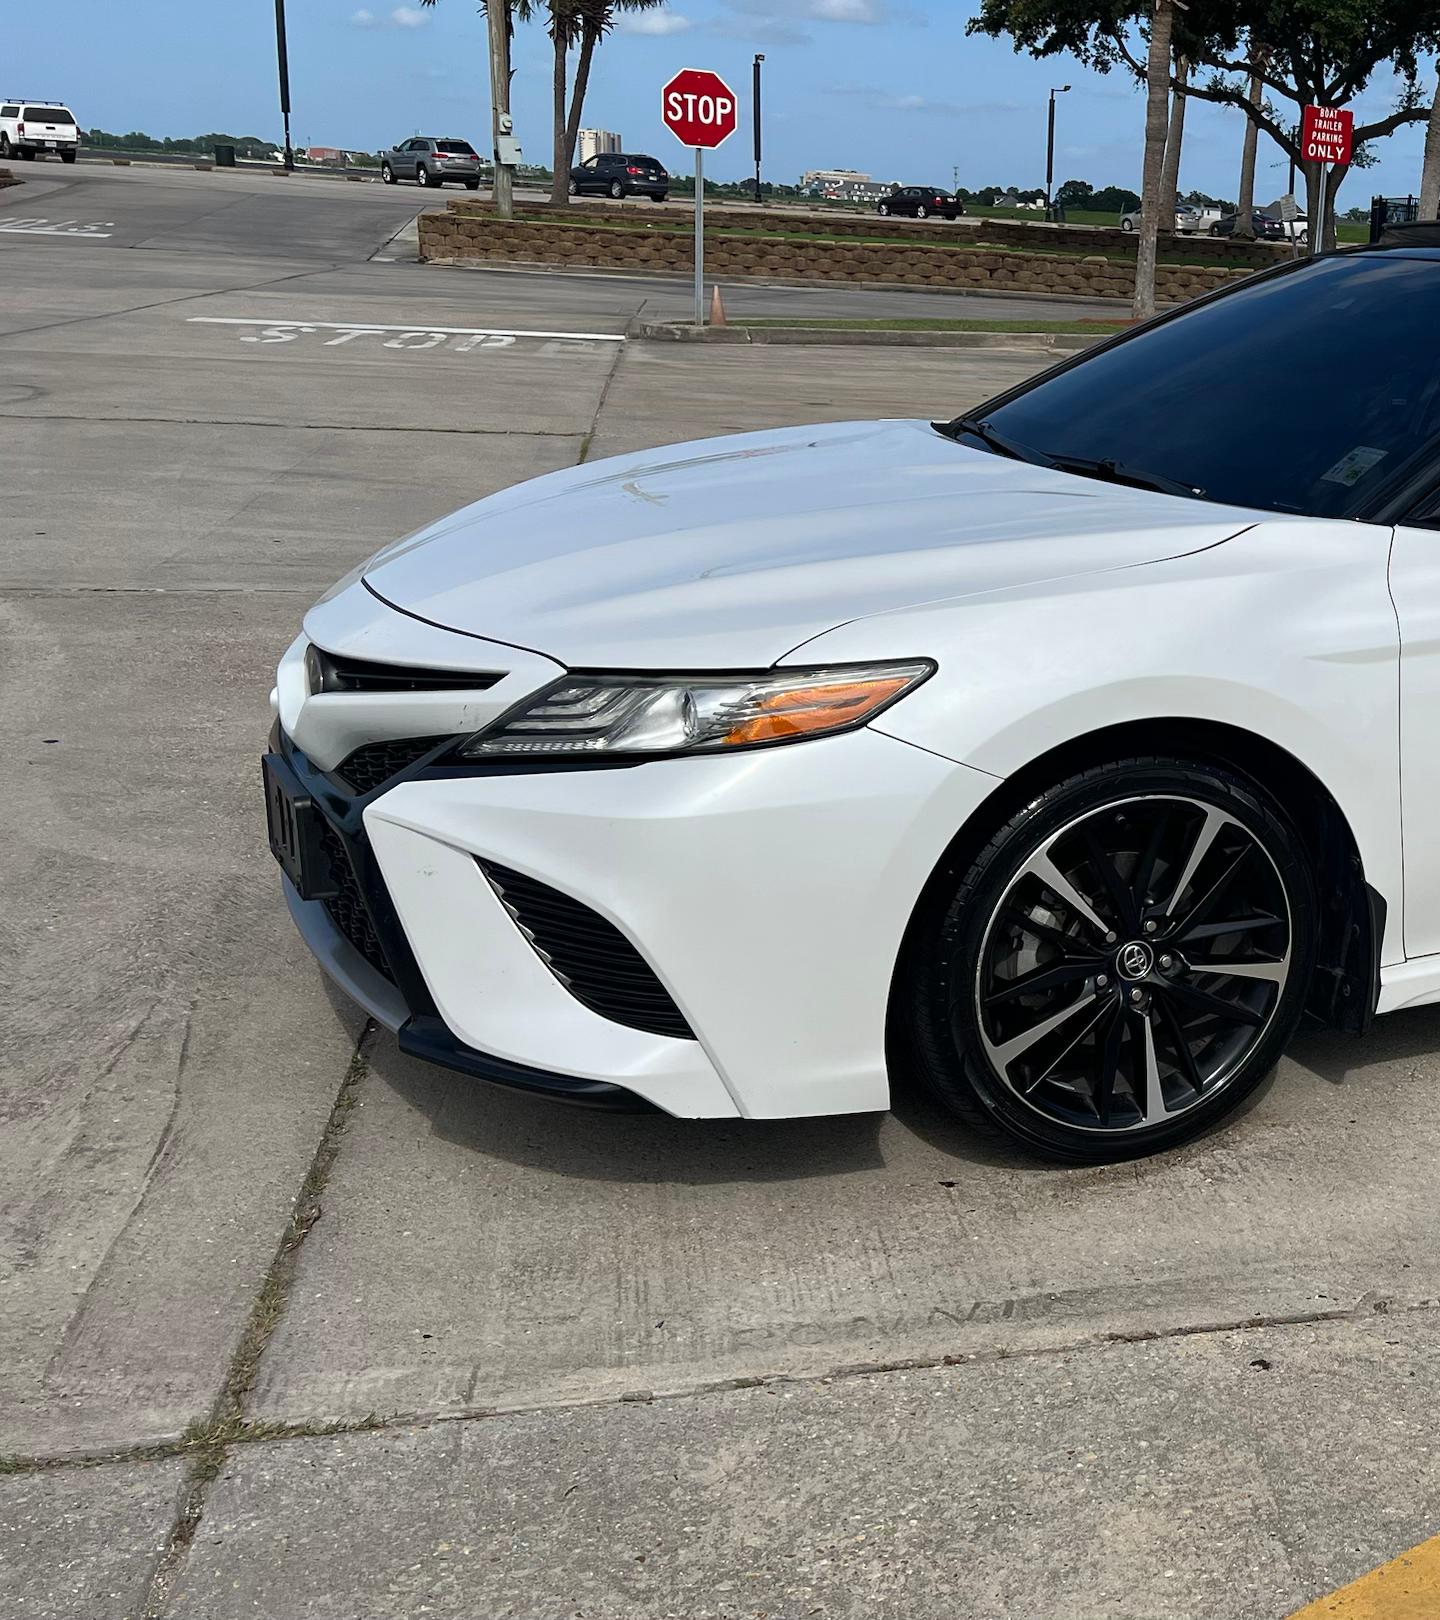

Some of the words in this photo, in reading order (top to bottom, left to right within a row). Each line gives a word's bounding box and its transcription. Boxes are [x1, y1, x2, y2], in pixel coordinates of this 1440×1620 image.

[667, 91, 732, 126] STOP
[1320, 107, 1339, 119] BOAT
[1314, 118, 1343, 132] TRAILER
[1311, 130, 1343, 144] PARKING
[1308, 143, 1345, 160] ONLY
[240, 326, 517, 353] STOP
